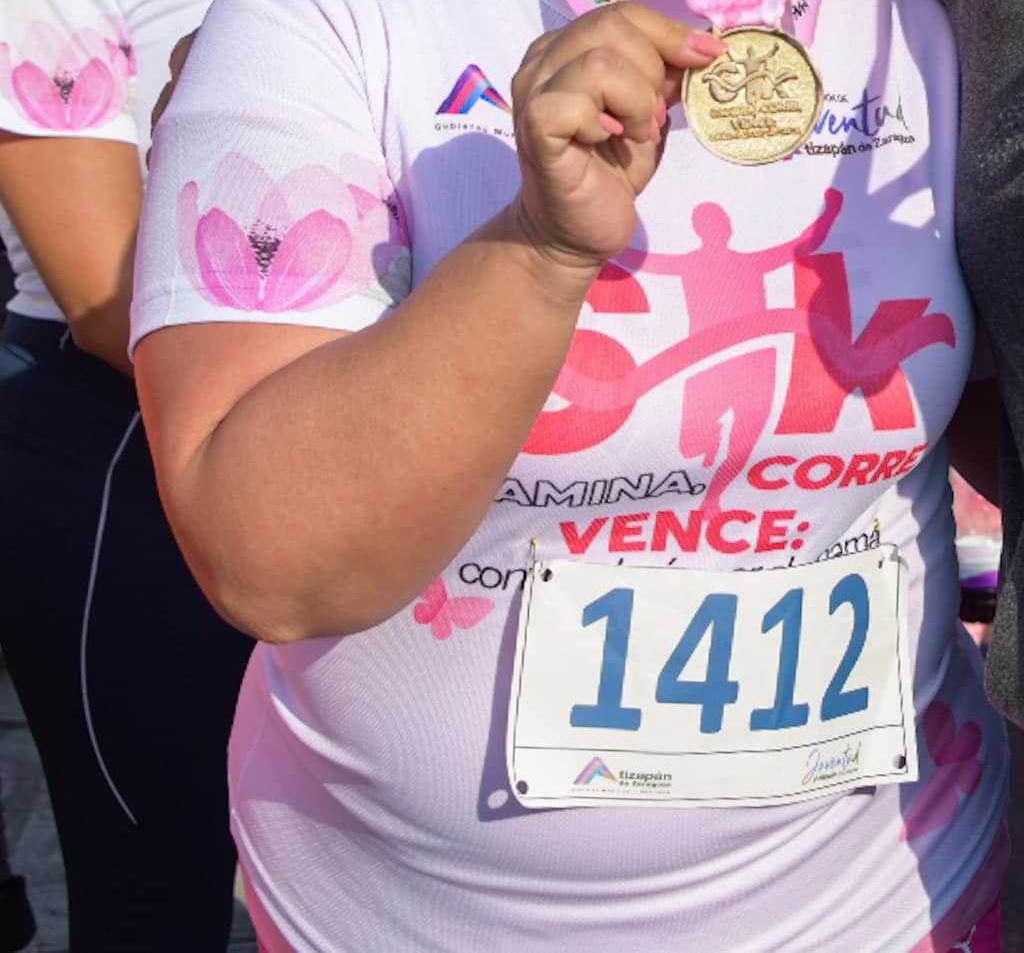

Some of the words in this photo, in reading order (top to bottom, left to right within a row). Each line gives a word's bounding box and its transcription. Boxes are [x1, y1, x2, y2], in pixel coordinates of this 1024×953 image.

[858, 143, 872, 153] de
[560, 510, 811, 555] VENCE:
[569, 572, 870, 734] 1412
